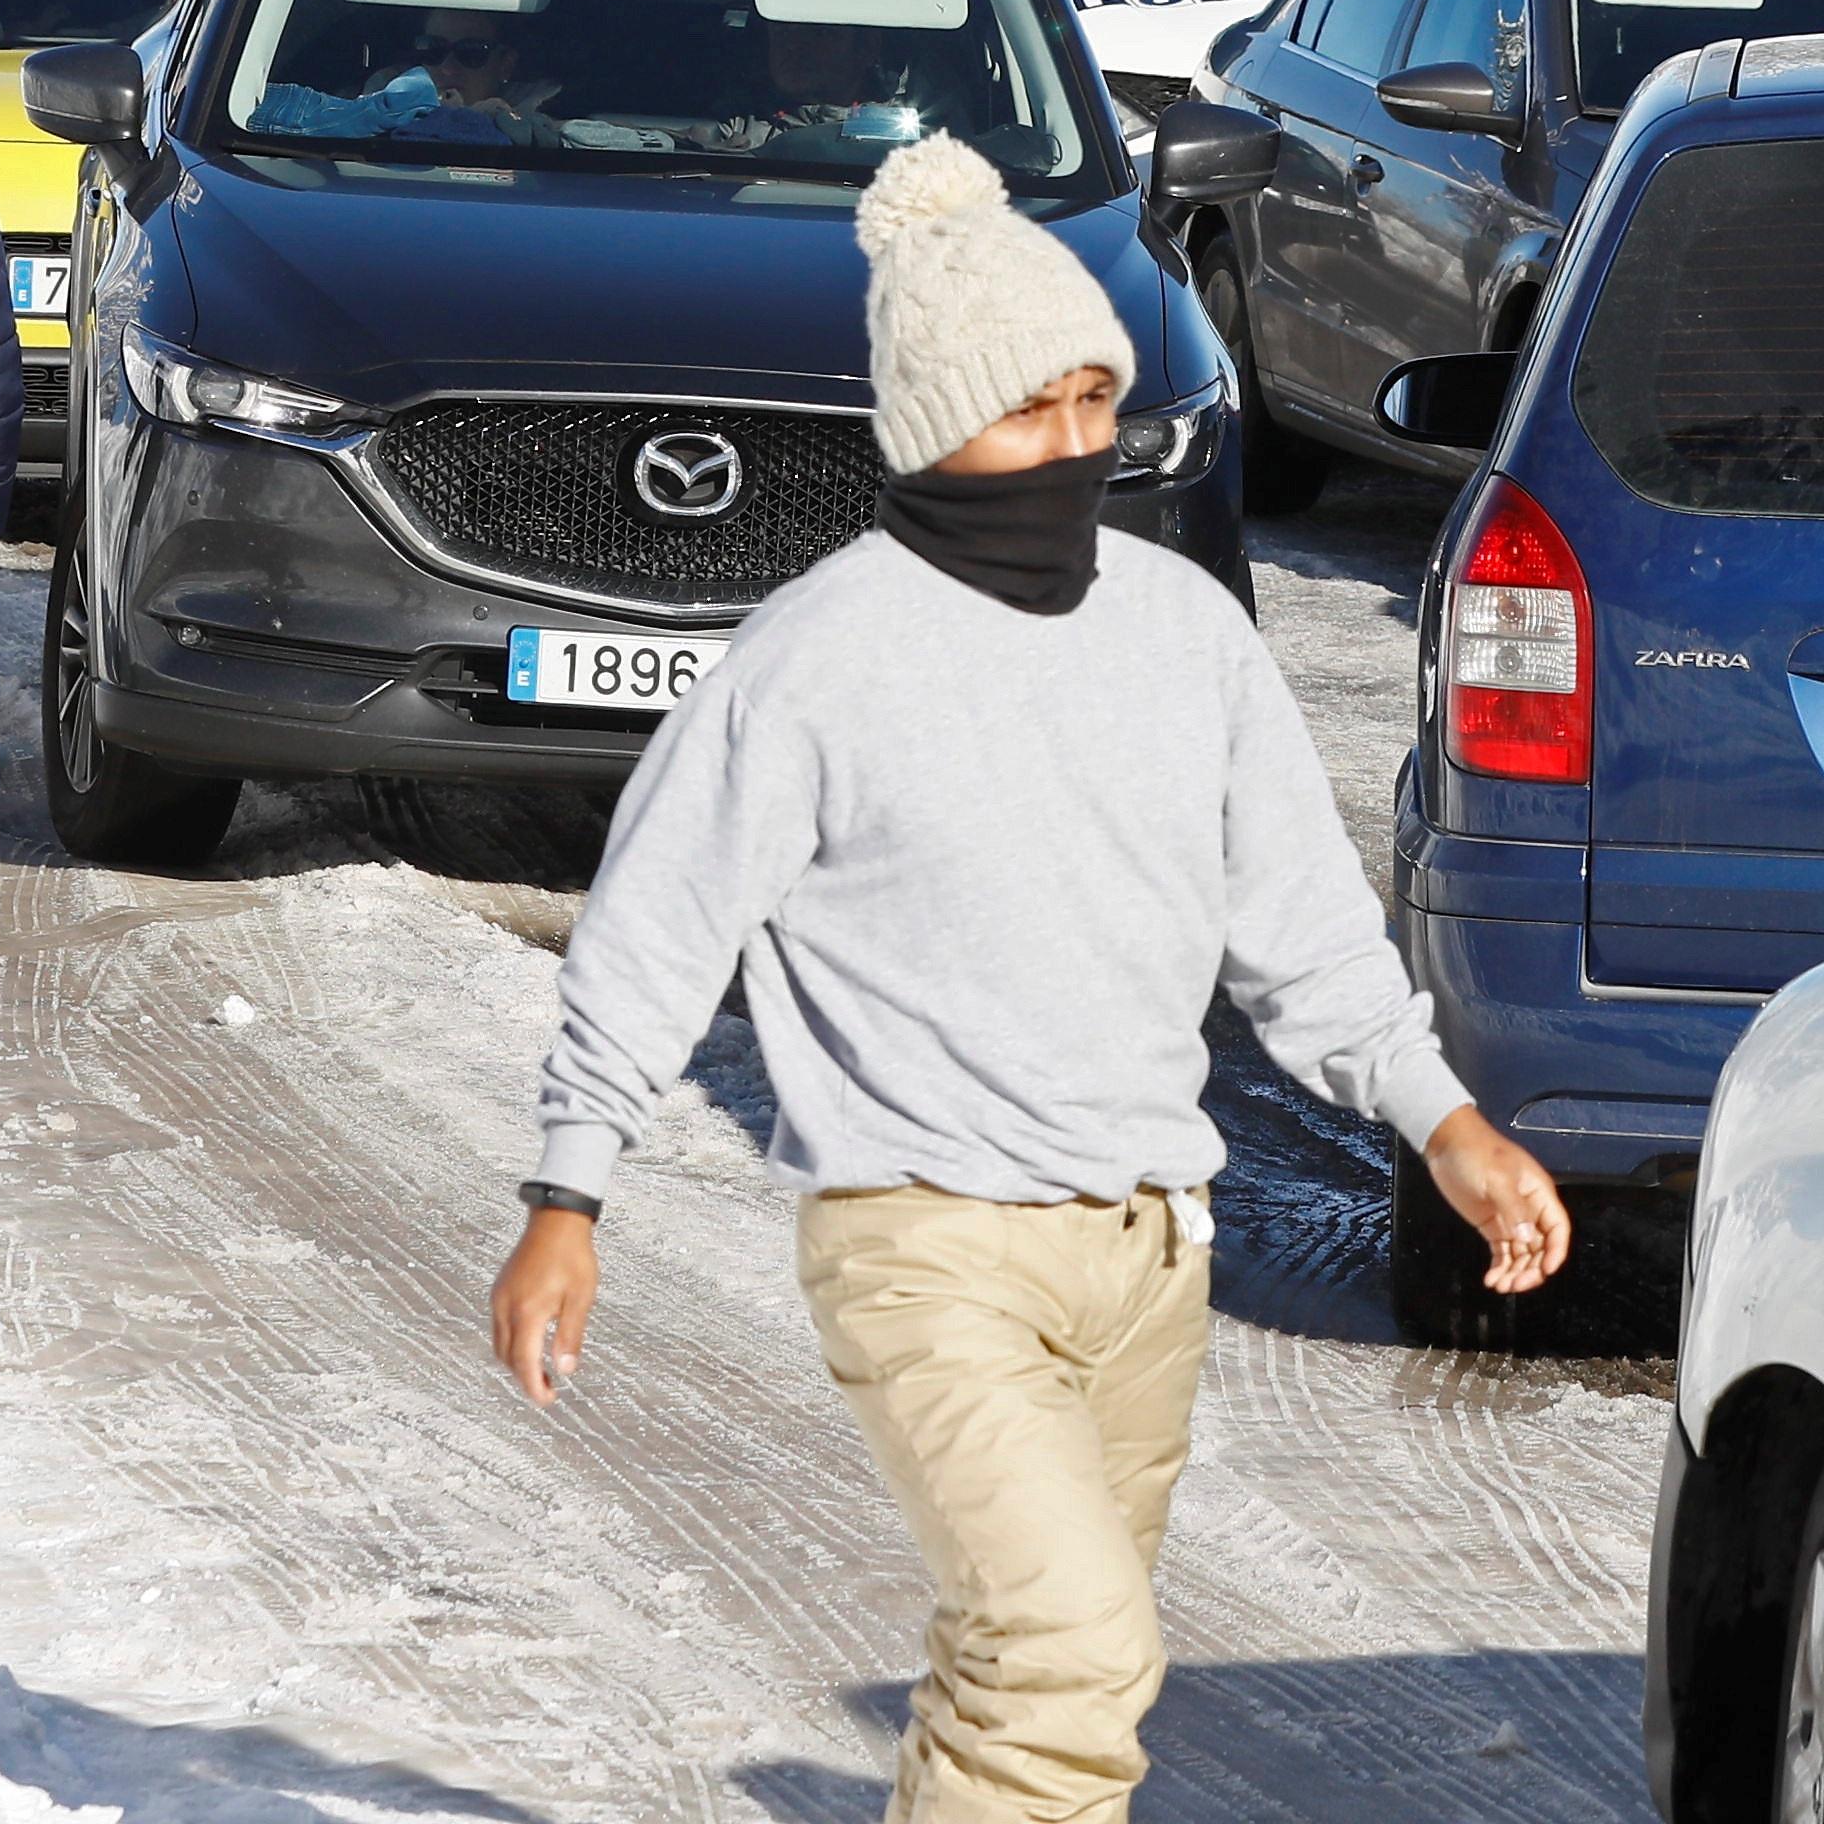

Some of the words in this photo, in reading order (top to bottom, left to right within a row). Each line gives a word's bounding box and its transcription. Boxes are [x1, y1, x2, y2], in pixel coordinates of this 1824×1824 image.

[18, 289, 27, 302] E
[45, 266, 68, 306] 7
[562, 642, 700, 700] 1896
[1634, 650, 1751, 672] ZAFIRA
[516, 670, 530, 687] E
